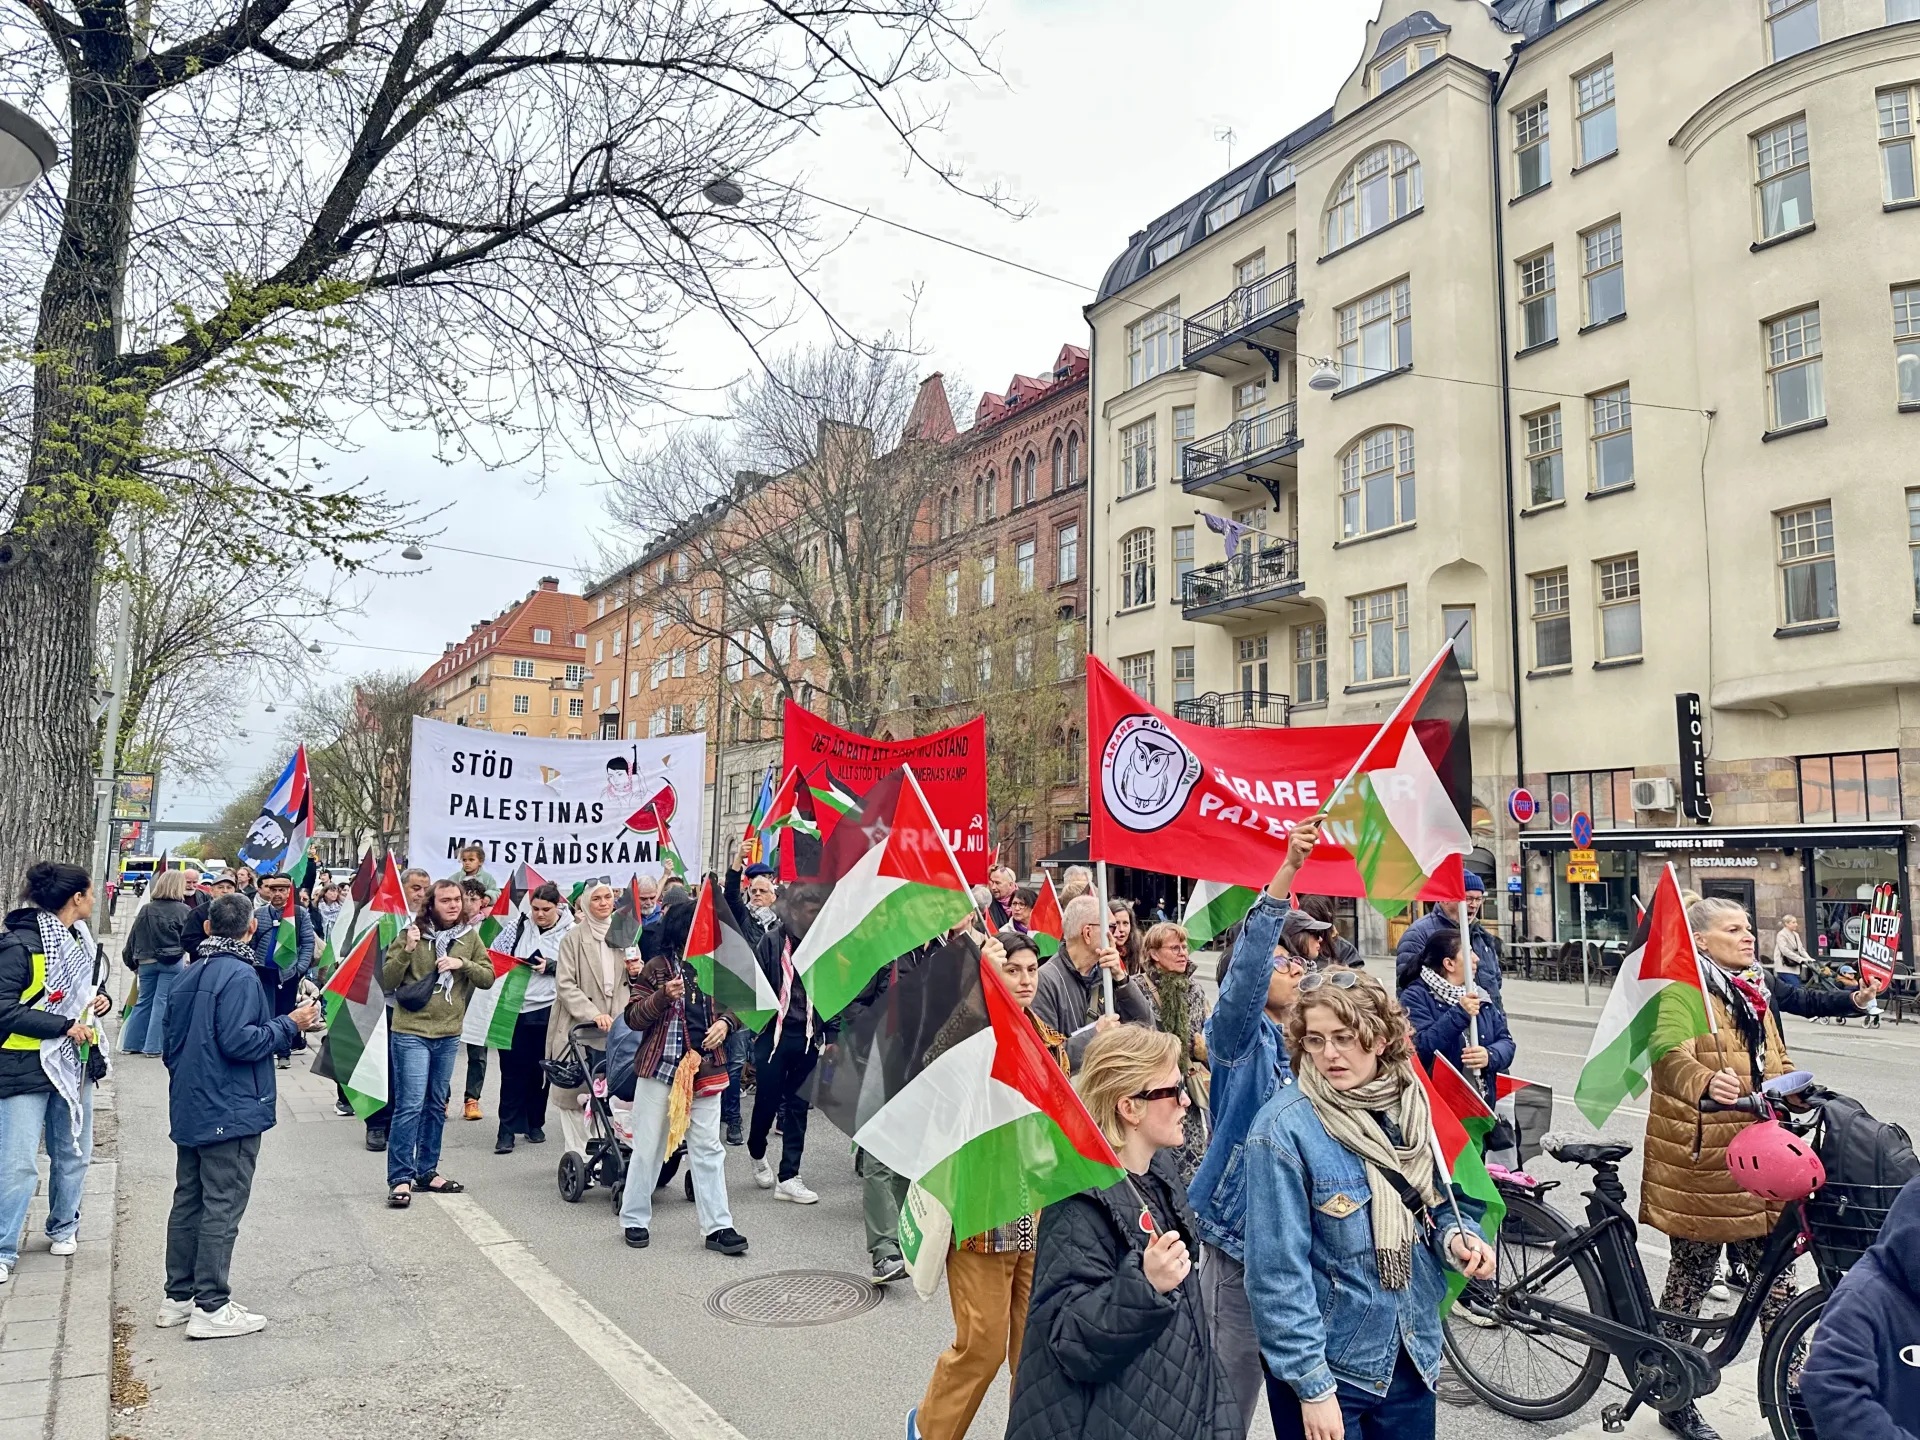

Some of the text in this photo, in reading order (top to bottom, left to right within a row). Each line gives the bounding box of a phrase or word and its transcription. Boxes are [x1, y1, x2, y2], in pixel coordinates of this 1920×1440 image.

[811, 731, 832, 754] DET
[871, 746, 890, 762] ATT
[1104, 719, 1135, 768] LÄRARE
[1689, 700, 1705, 797] HOTEL
[451, 749, 513, 780] STÖD
[838, 764, 854, 780] ALLT
[450, 793, 604, 824] PALESTINAS
[1654, 839, 1725, 848] BURGERS & BEER
[1689, 857, 1759, 867] RESTAURANG
[1746, 1270, 1765, 1302] ECORIDE
